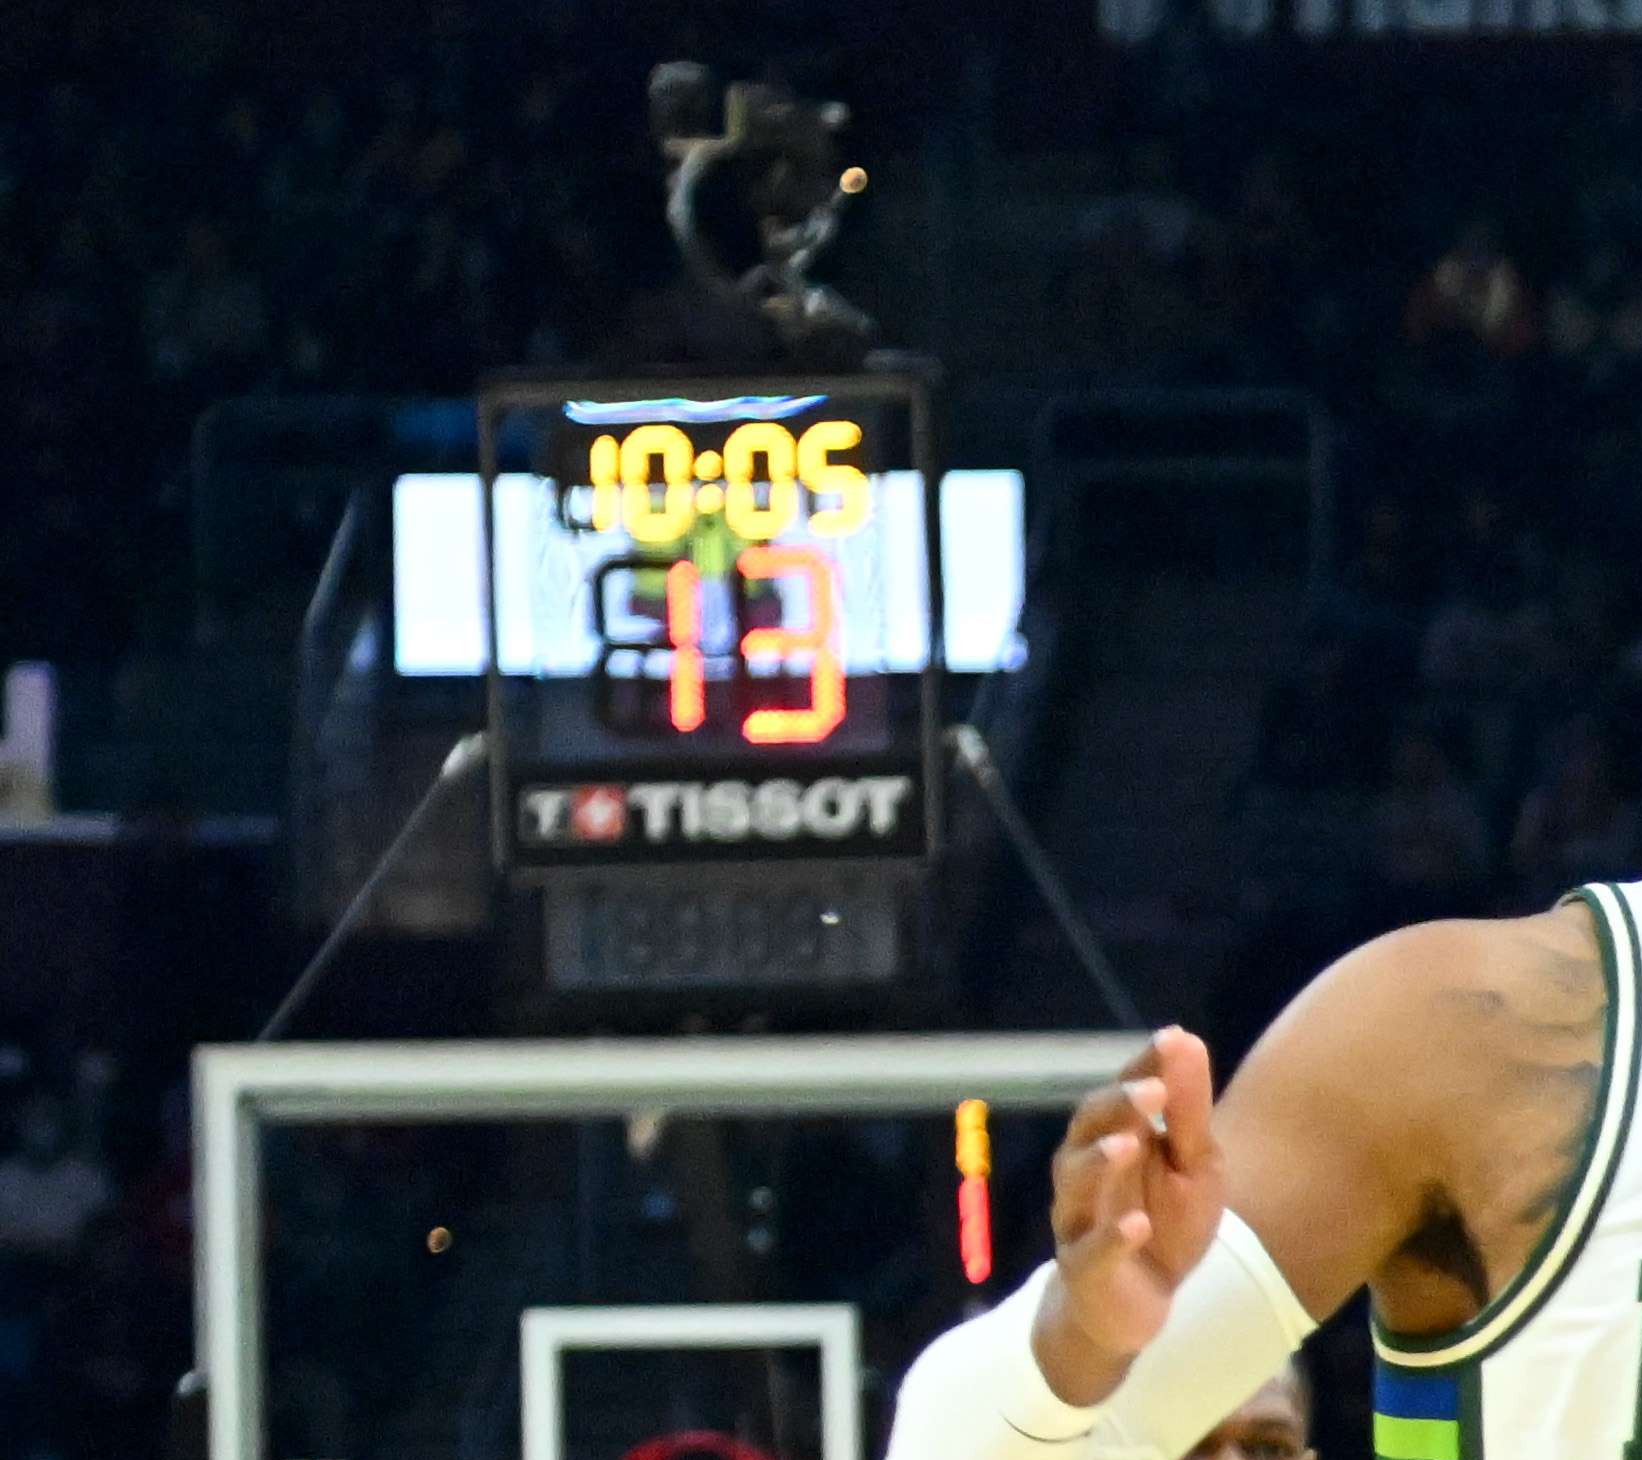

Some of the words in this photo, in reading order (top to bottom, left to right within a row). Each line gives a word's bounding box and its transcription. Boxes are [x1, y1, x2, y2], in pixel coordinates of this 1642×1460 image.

[590, 420, 872, 542] 10:05
[666, 545, 847, 744] 13
[627, 775, 911, 843] TISSOT
